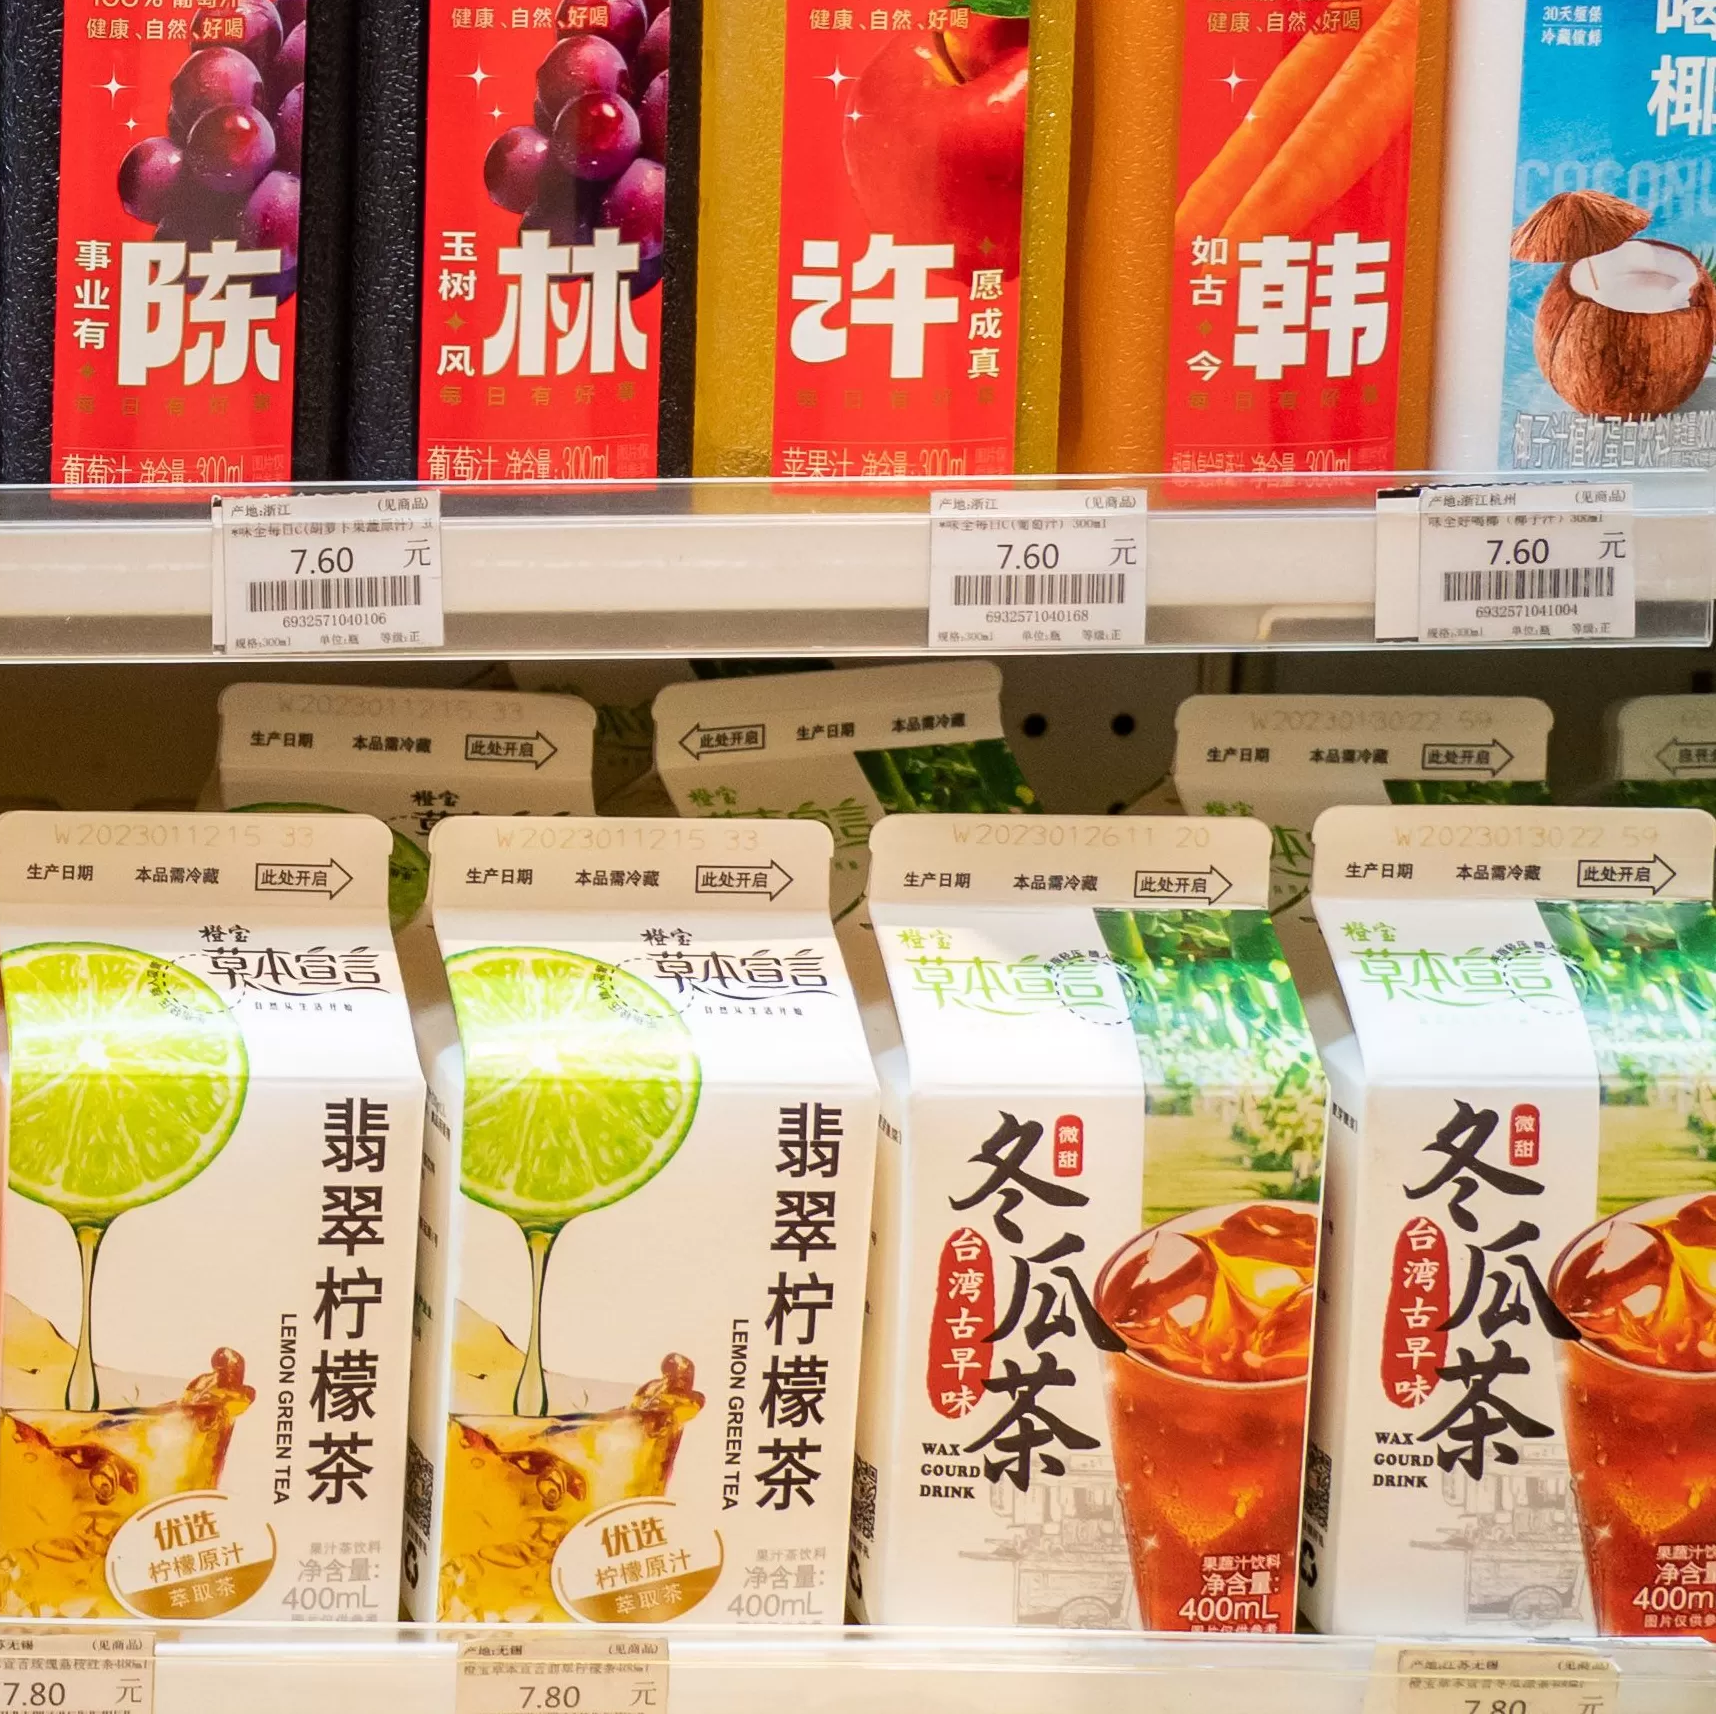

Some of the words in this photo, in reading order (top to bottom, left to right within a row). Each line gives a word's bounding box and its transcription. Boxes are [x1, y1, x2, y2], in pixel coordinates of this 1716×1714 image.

[483, 228, 647, 378] 林
[791, 233, 959, 379] 许
[1233, 232, 1390, 381] 韩
[968, 269, 1004, 379] 愿成真
[290, 547, 354, 576] 7.60
[403, 539, 432, 570] 元
[997, 543, 1059, 571] 7.60
[1108, 538, 1138, 567] 元
[282, 611, 387, 628] 6932571040106
[1346, 861, 1413, 880] 生产日期
[1457, 862, 1541, 881] 本品需冷藏
[1584, 865, 1651, 883] 此处开启
[306, 1096, 390, 1505] 翡翠柠檬茶
[754, 1102, 844, 1512] 翡翠柠檬茶
[949, 1109, 1127, 1493] 冬瓜茶
[1403, 1099, 1582, 1483] 冬瓜茶
[941, 1229, 984, 1419] 台湾古早味
[922, 1441, 961, 1458] WAX
[920, 1462, 981, 1480] GOURD
[919, 1484, 976, 1501] DRINK
[1179, 1598, 1279, 1623] 400mL
[3, 1679, 67, 1707] 7.80
[114, 1677, 145, 1705] 元
[518, 1684, 582, 1710] 7.80
[630, 1681, 658, 1707] 元
